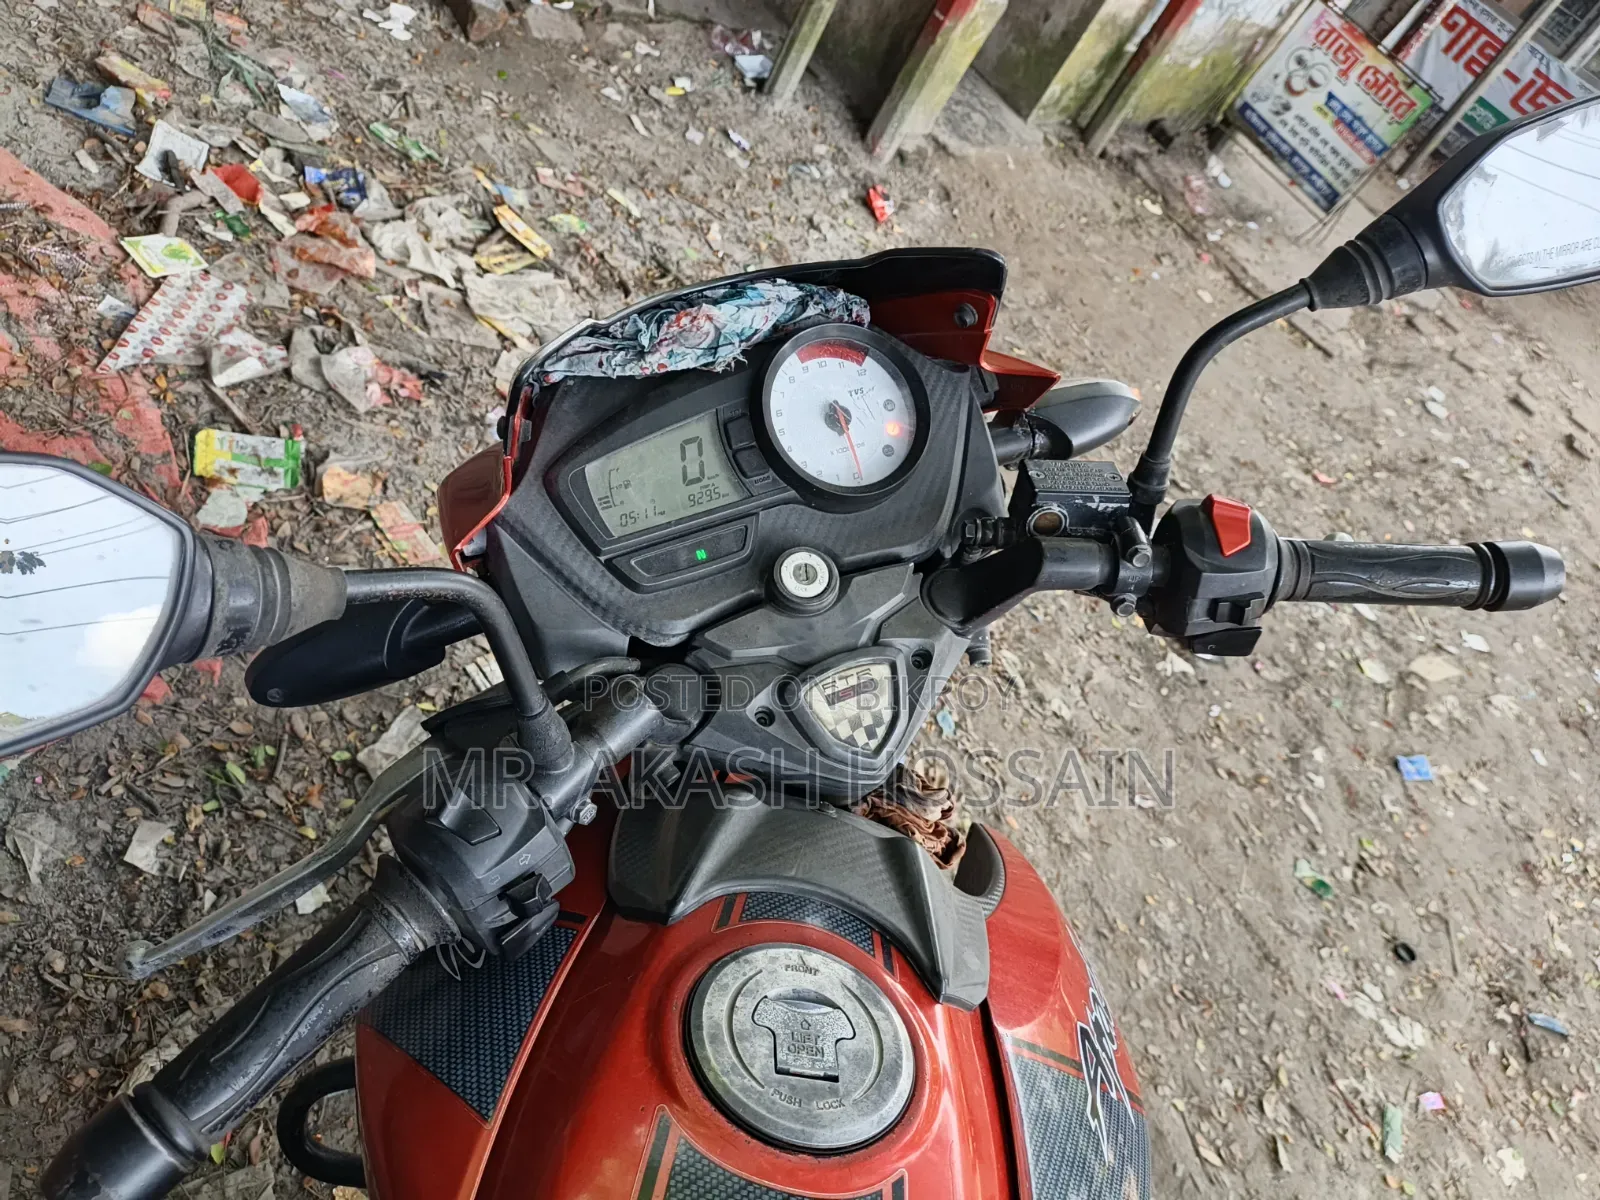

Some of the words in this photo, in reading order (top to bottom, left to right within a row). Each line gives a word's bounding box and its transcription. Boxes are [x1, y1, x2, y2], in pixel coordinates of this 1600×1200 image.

[1313, 20, 1365, 85] রাজু
[1357, 65, 1418, 124] স্টোর
[856, 368, 867, 377] 12
[789, 376, 796, 384] 8
[848, 387, 865, 397] TVS
[776, 409, 783, 417] 6
[779, 428, 786, 437] 5
[680, 436, 705, 487] 0
[696, 549, 707, 561] N
[822, 668, 873, 692] RTR
[784, 964, 821, 977] FRONT
[786, 1043, 825, 1059] OPEN
[770, 1088, 803, 1108] PUSH
[815, 1098, 846, 1111] LOCK
